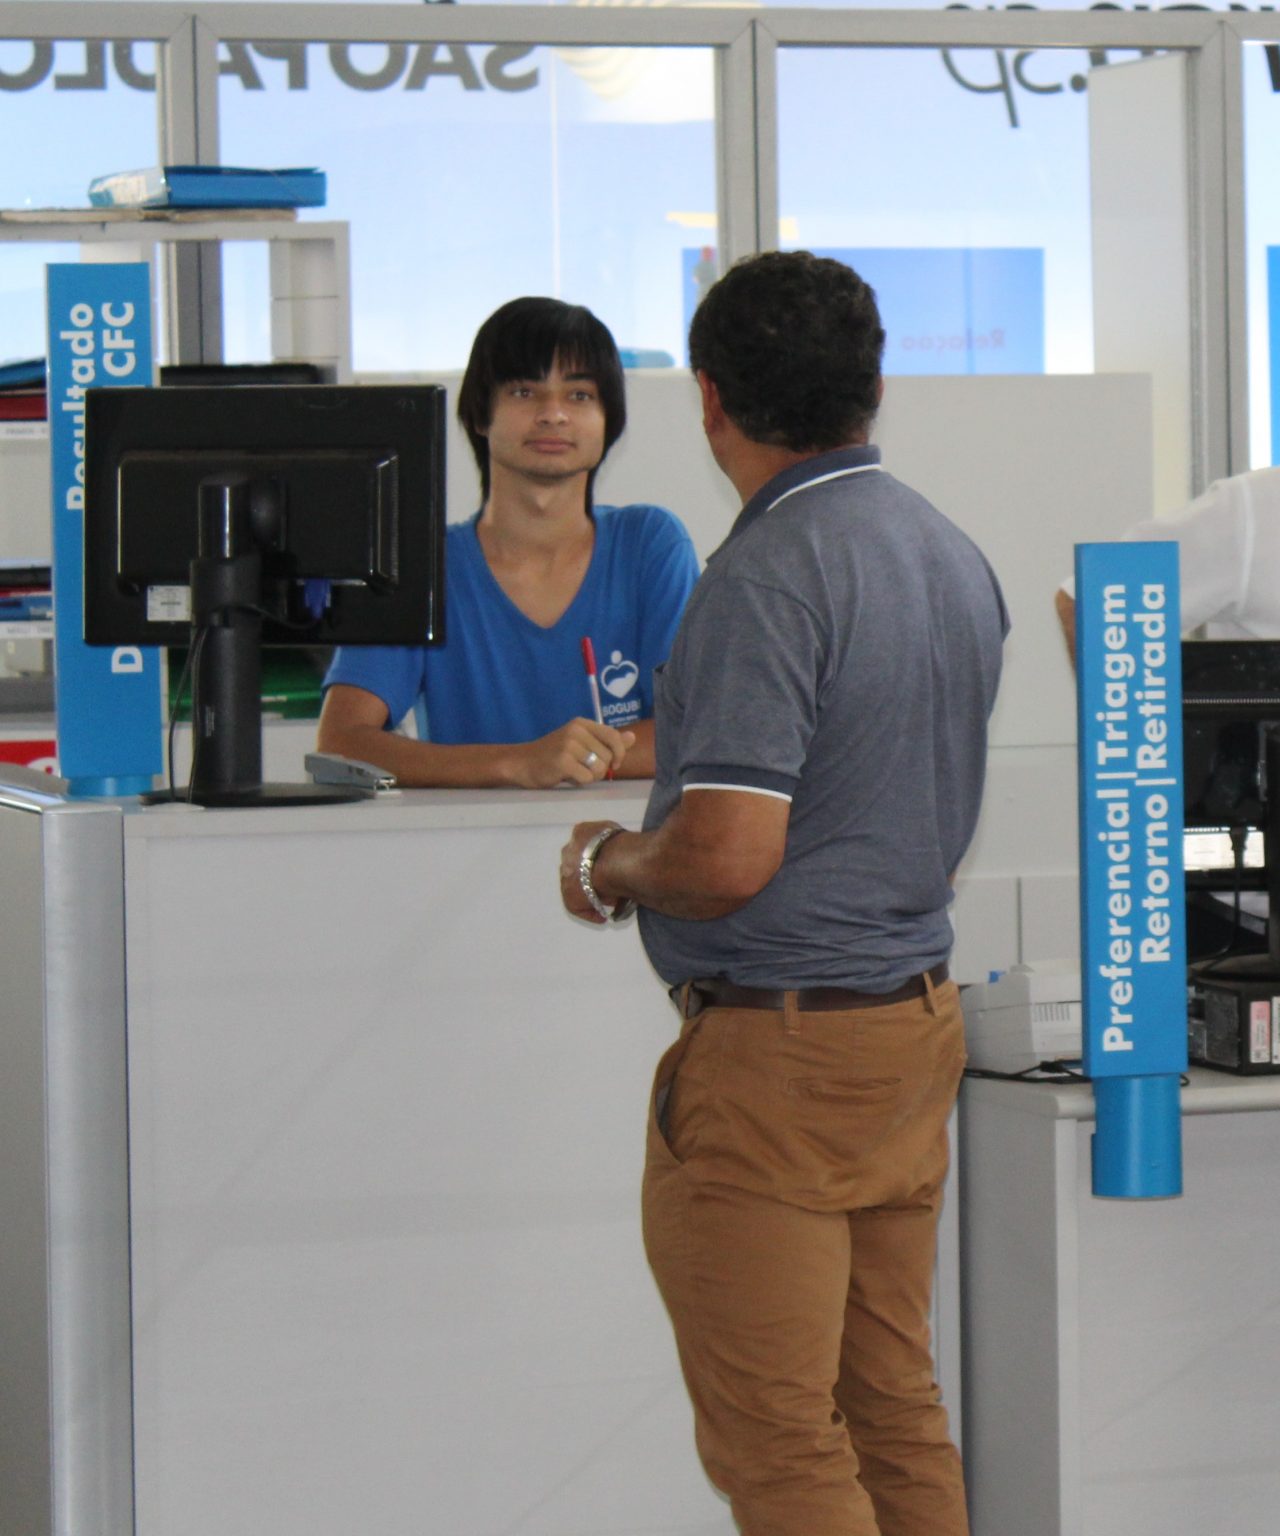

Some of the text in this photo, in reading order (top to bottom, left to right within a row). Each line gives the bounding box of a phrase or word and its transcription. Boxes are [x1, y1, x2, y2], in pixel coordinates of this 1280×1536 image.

[101, 302, 136, 377] CFC
[603, 700, 640, 717] SOGUB
[1096, 584, 1136, 1052] Preferencial Triagem
[1132, 583, 1171, 963] Retorno Retirada
